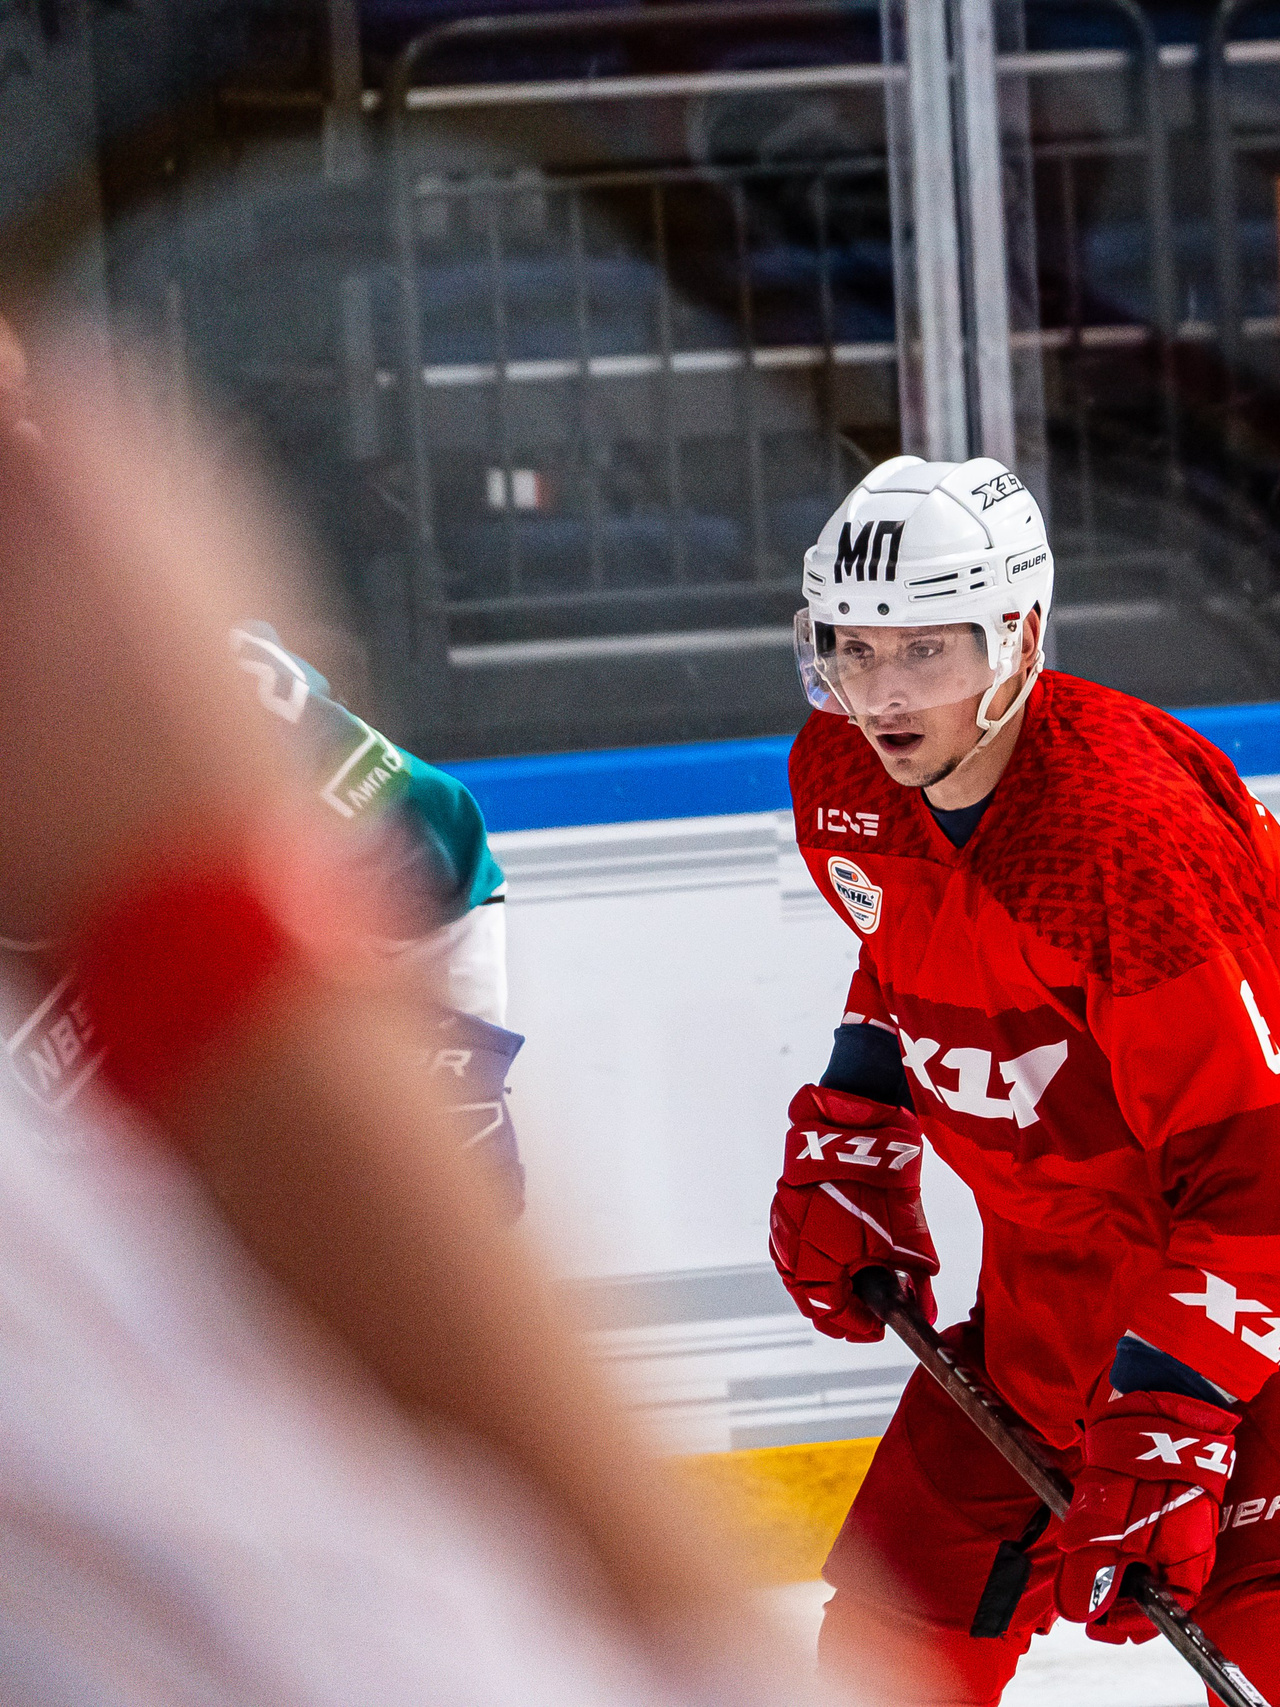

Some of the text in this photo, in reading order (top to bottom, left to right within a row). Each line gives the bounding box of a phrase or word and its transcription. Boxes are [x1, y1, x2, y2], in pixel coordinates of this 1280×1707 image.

[834, 520, 905, 583] МП
[1012, 553, 1047, 575] BAUER
[796, 1131, 920, 1171] X17
[1136, 1432, 1236, 1480] X1
